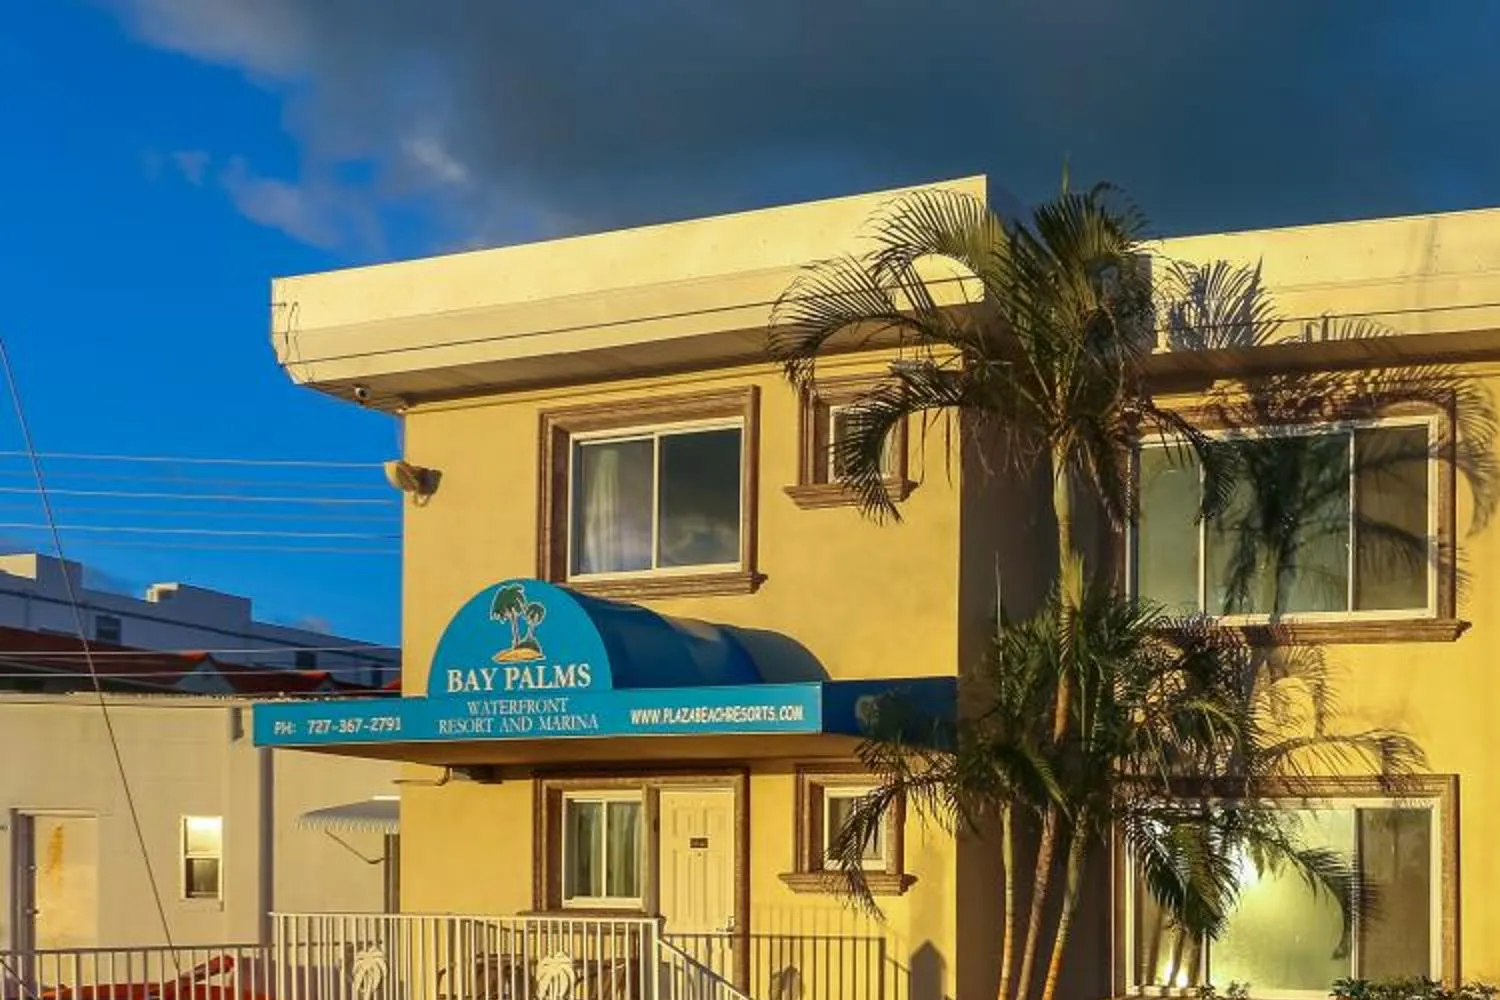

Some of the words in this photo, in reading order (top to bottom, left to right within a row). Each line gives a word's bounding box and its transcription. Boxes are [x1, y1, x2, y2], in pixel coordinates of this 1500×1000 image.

[447, 668, 498, 693] BAY
[504, 663, 592, 690] PALMS
[467, 697, 569, 716] WATERFRONT
[274, 721, 296, 735] PH:
[307, 717, 401, 735] 727-367-2791
[439, 717, 494, 734] RESORT
[500, 715, 533, 732] AND
[539, 713, 600, 731] MARINA
